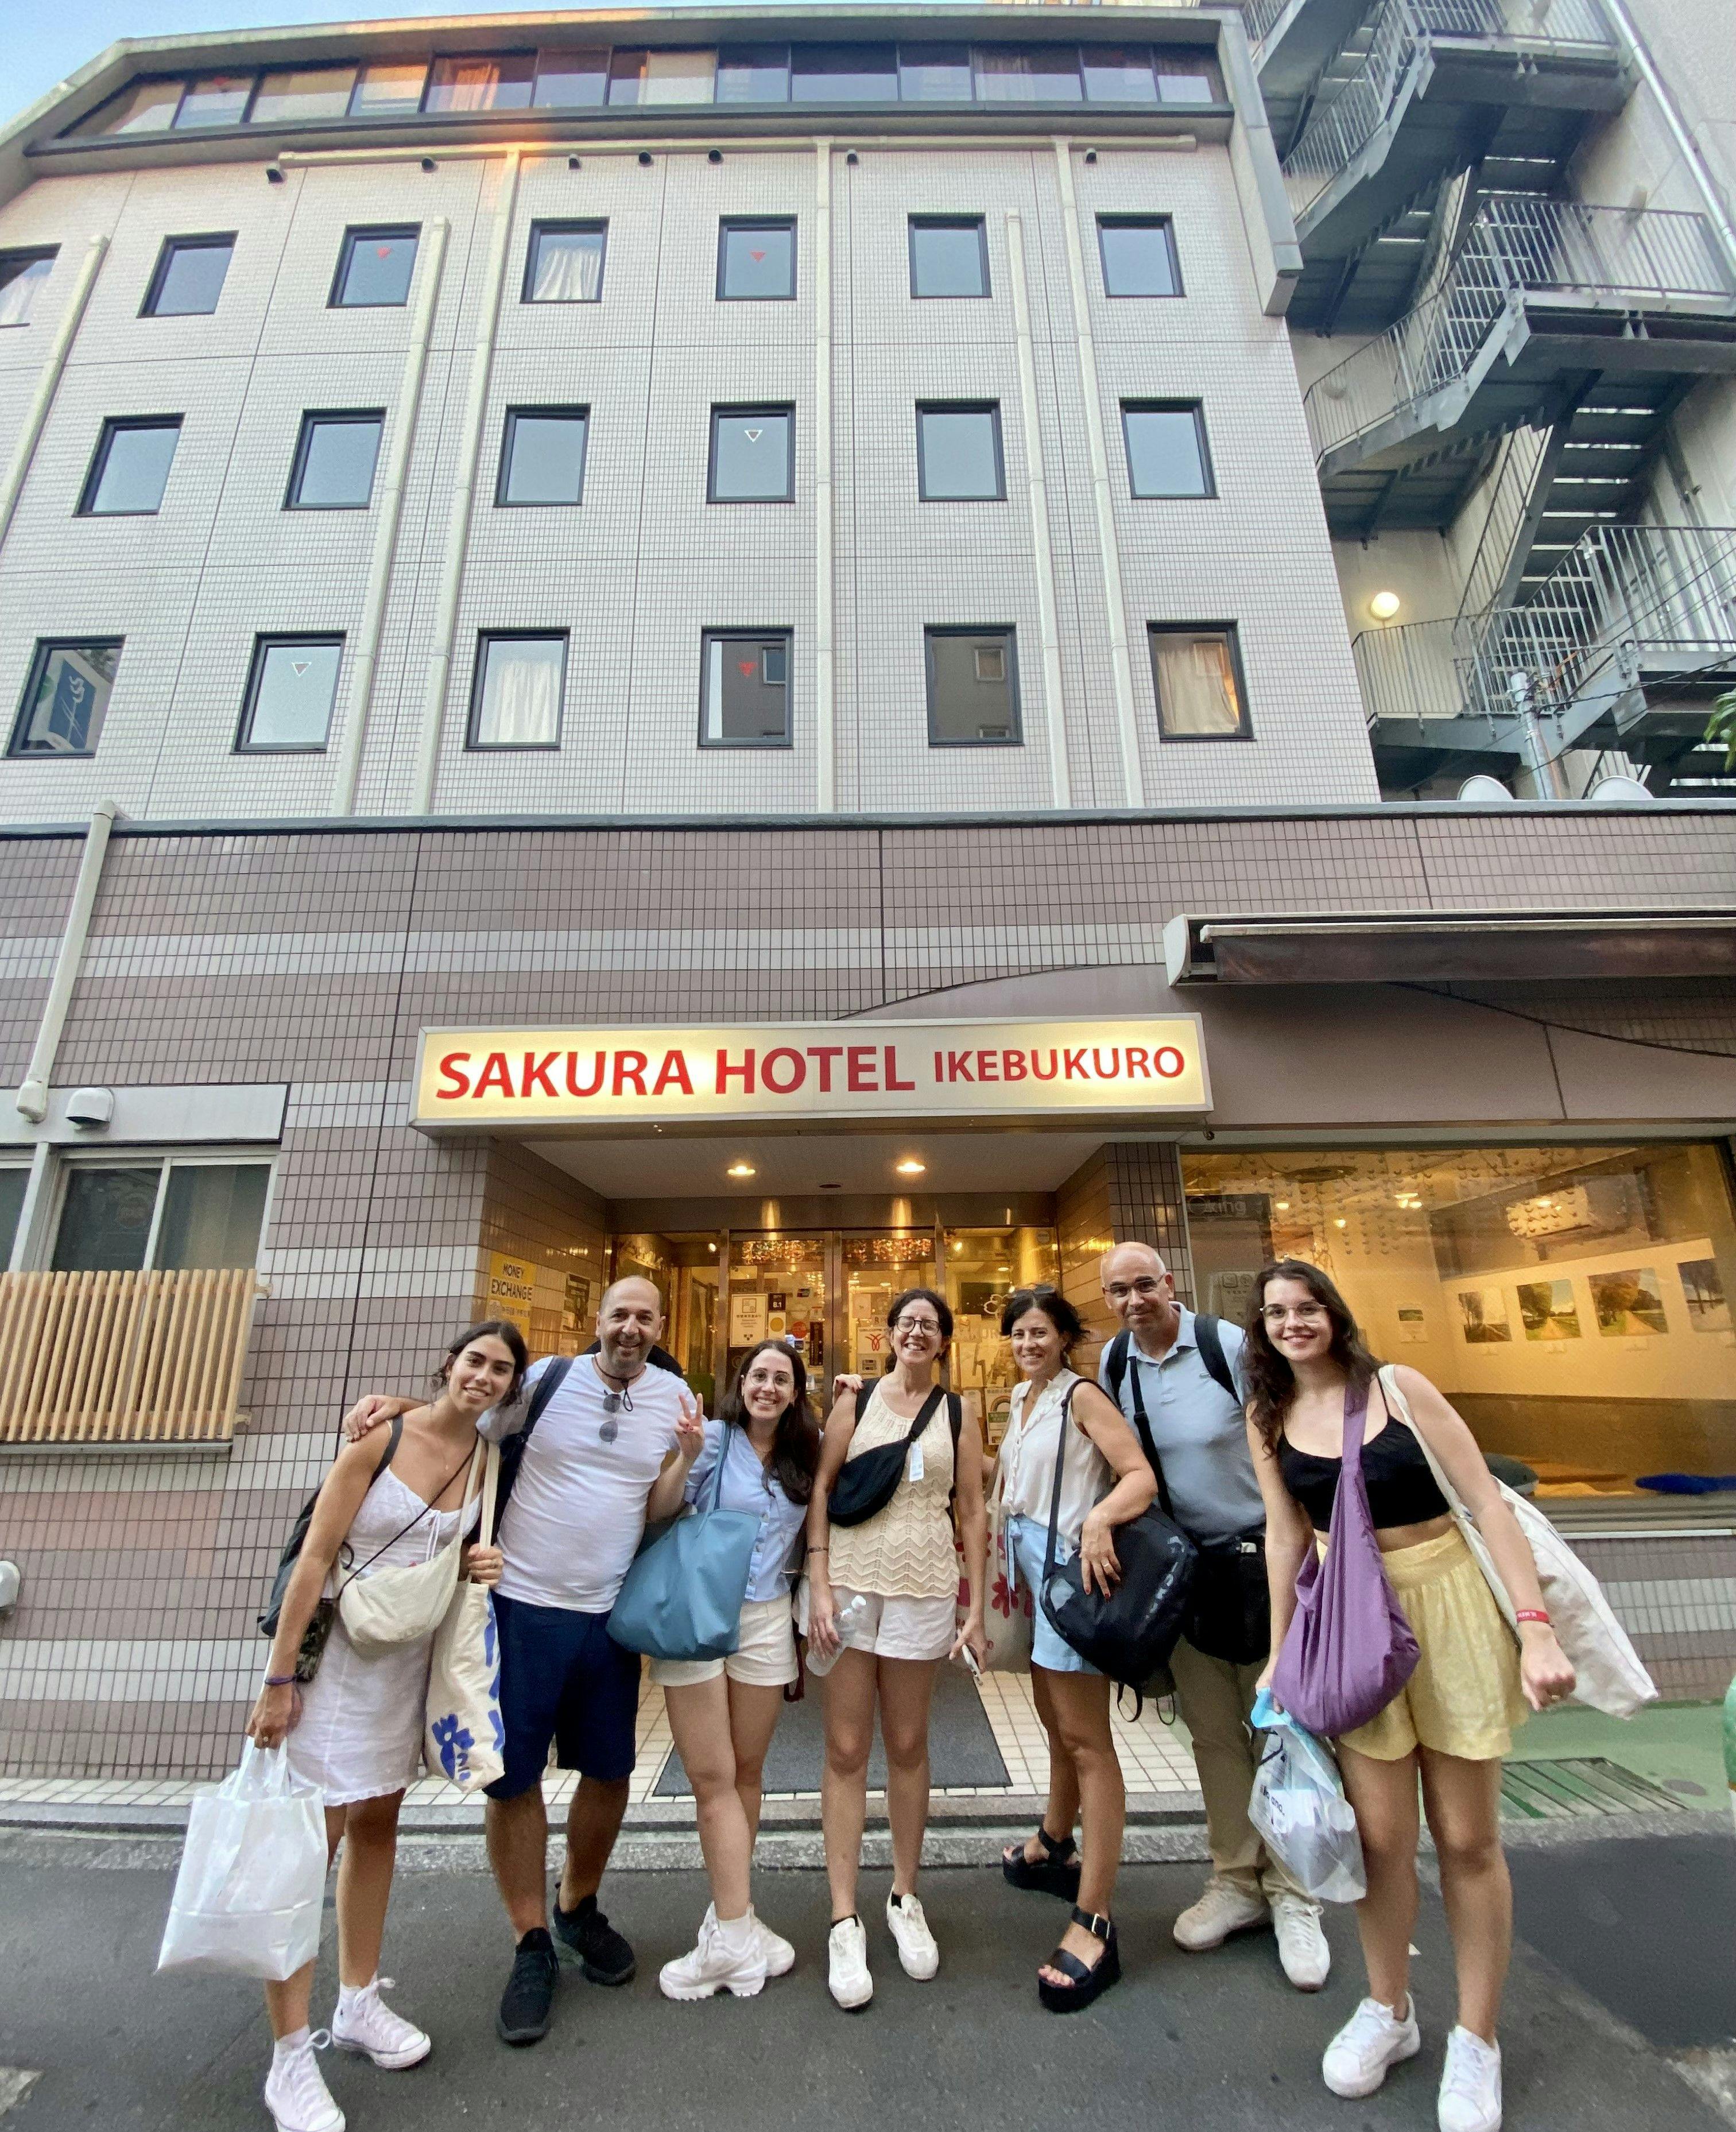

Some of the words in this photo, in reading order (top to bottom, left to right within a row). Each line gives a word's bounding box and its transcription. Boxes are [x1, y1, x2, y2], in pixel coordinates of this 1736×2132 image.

[437, 1051, 693, 1099] SAKURA
[716, 1046, 915, 1094] HOTEL
[935, 1047, 1185, 1082] IKEBUKURO
[503, 1263, 524, 1278] MONEY
[491, 1278, 533, 1301] EXCHANGE
